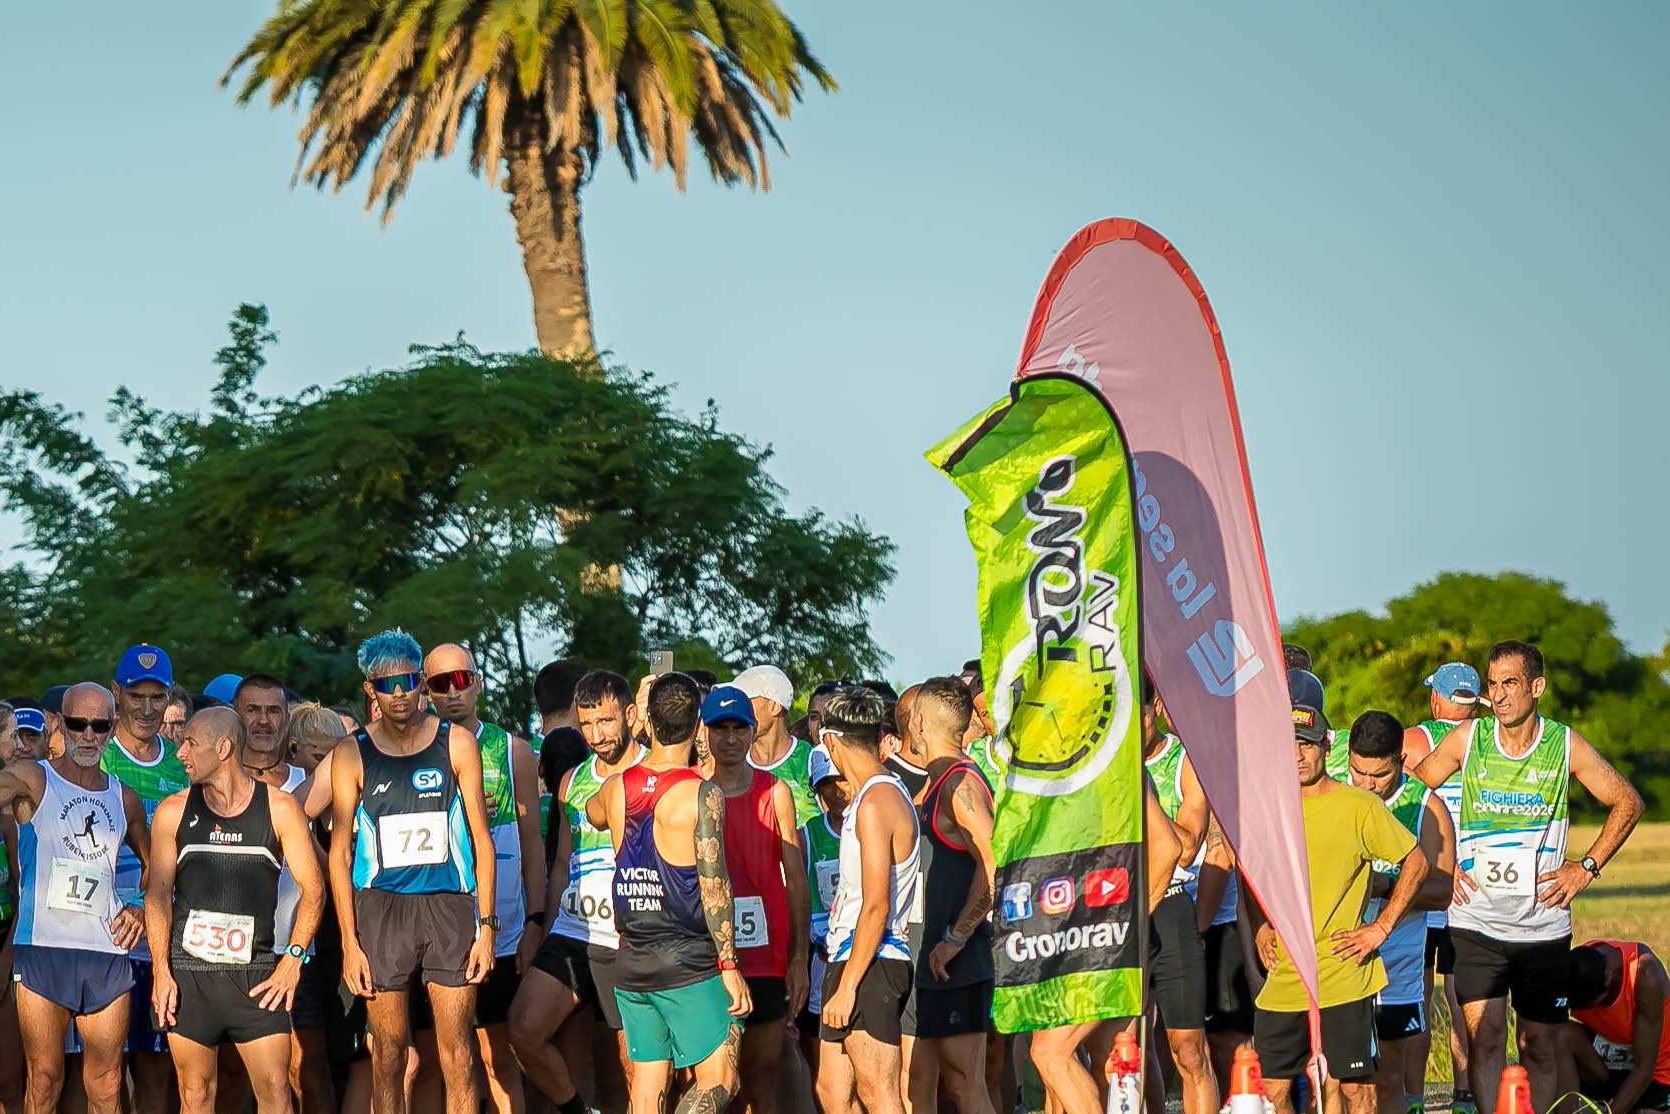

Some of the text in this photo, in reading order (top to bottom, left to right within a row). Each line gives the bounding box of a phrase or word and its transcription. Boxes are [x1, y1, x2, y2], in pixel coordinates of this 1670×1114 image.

[1480, 789, 1545, 806] FIGHIERA
[398, 828, 434, 853] 72
[1486, 861, 1519, 884] 36
[66, 875, 100, 901] 17
[567, 892, 612, 920] 106
[628, 898, 662, 912] TEAM
[735, 911, 756, 936] 5
[188, 922, 247, 953] 530
